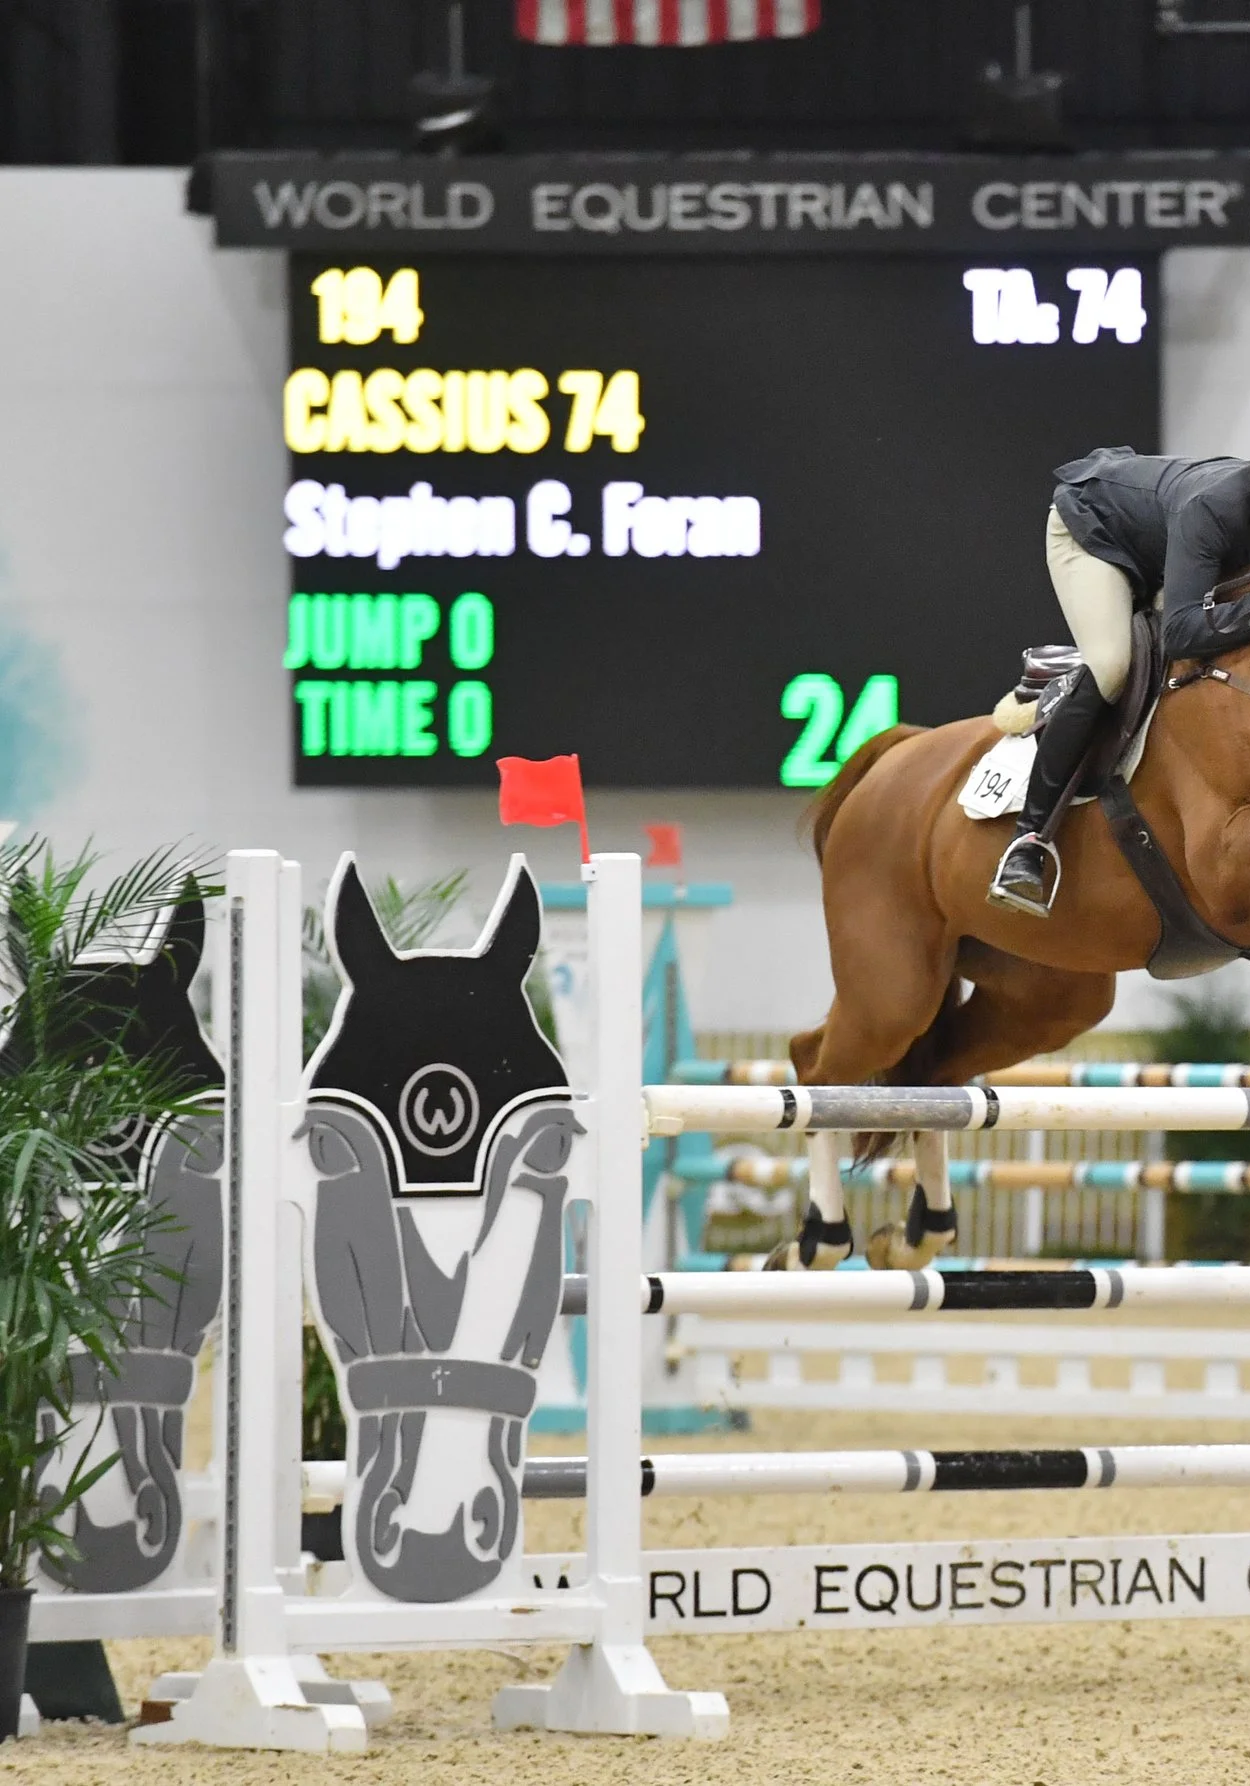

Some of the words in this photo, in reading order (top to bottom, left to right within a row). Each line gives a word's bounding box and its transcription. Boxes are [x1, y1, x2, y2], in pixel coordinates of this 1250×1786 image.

[253, 181, 495, 230] WORLD
[532, 181, 933, 233] EQUESTRIAN
[311, 266, 424, 344] 194
[1066, 268, 1147, 344] 74
[284, 367, 550, 453] CASSIUS
[558, 370, 645, 453] 74
[283, 479, 516, 570] Stephen
[526, 479, 591, 557] C.
[602, 481, 761, 557] Foran
[283, 593, 440, 669] JUMP
[449, 593, 494, 669] 0
[295, 681, 438, 756] TIME
[448, 681, 492, 757] 0
[974, 769, 1012, 803] 194
[813, 1556, 1206, 1615] EQUESTRIAN
